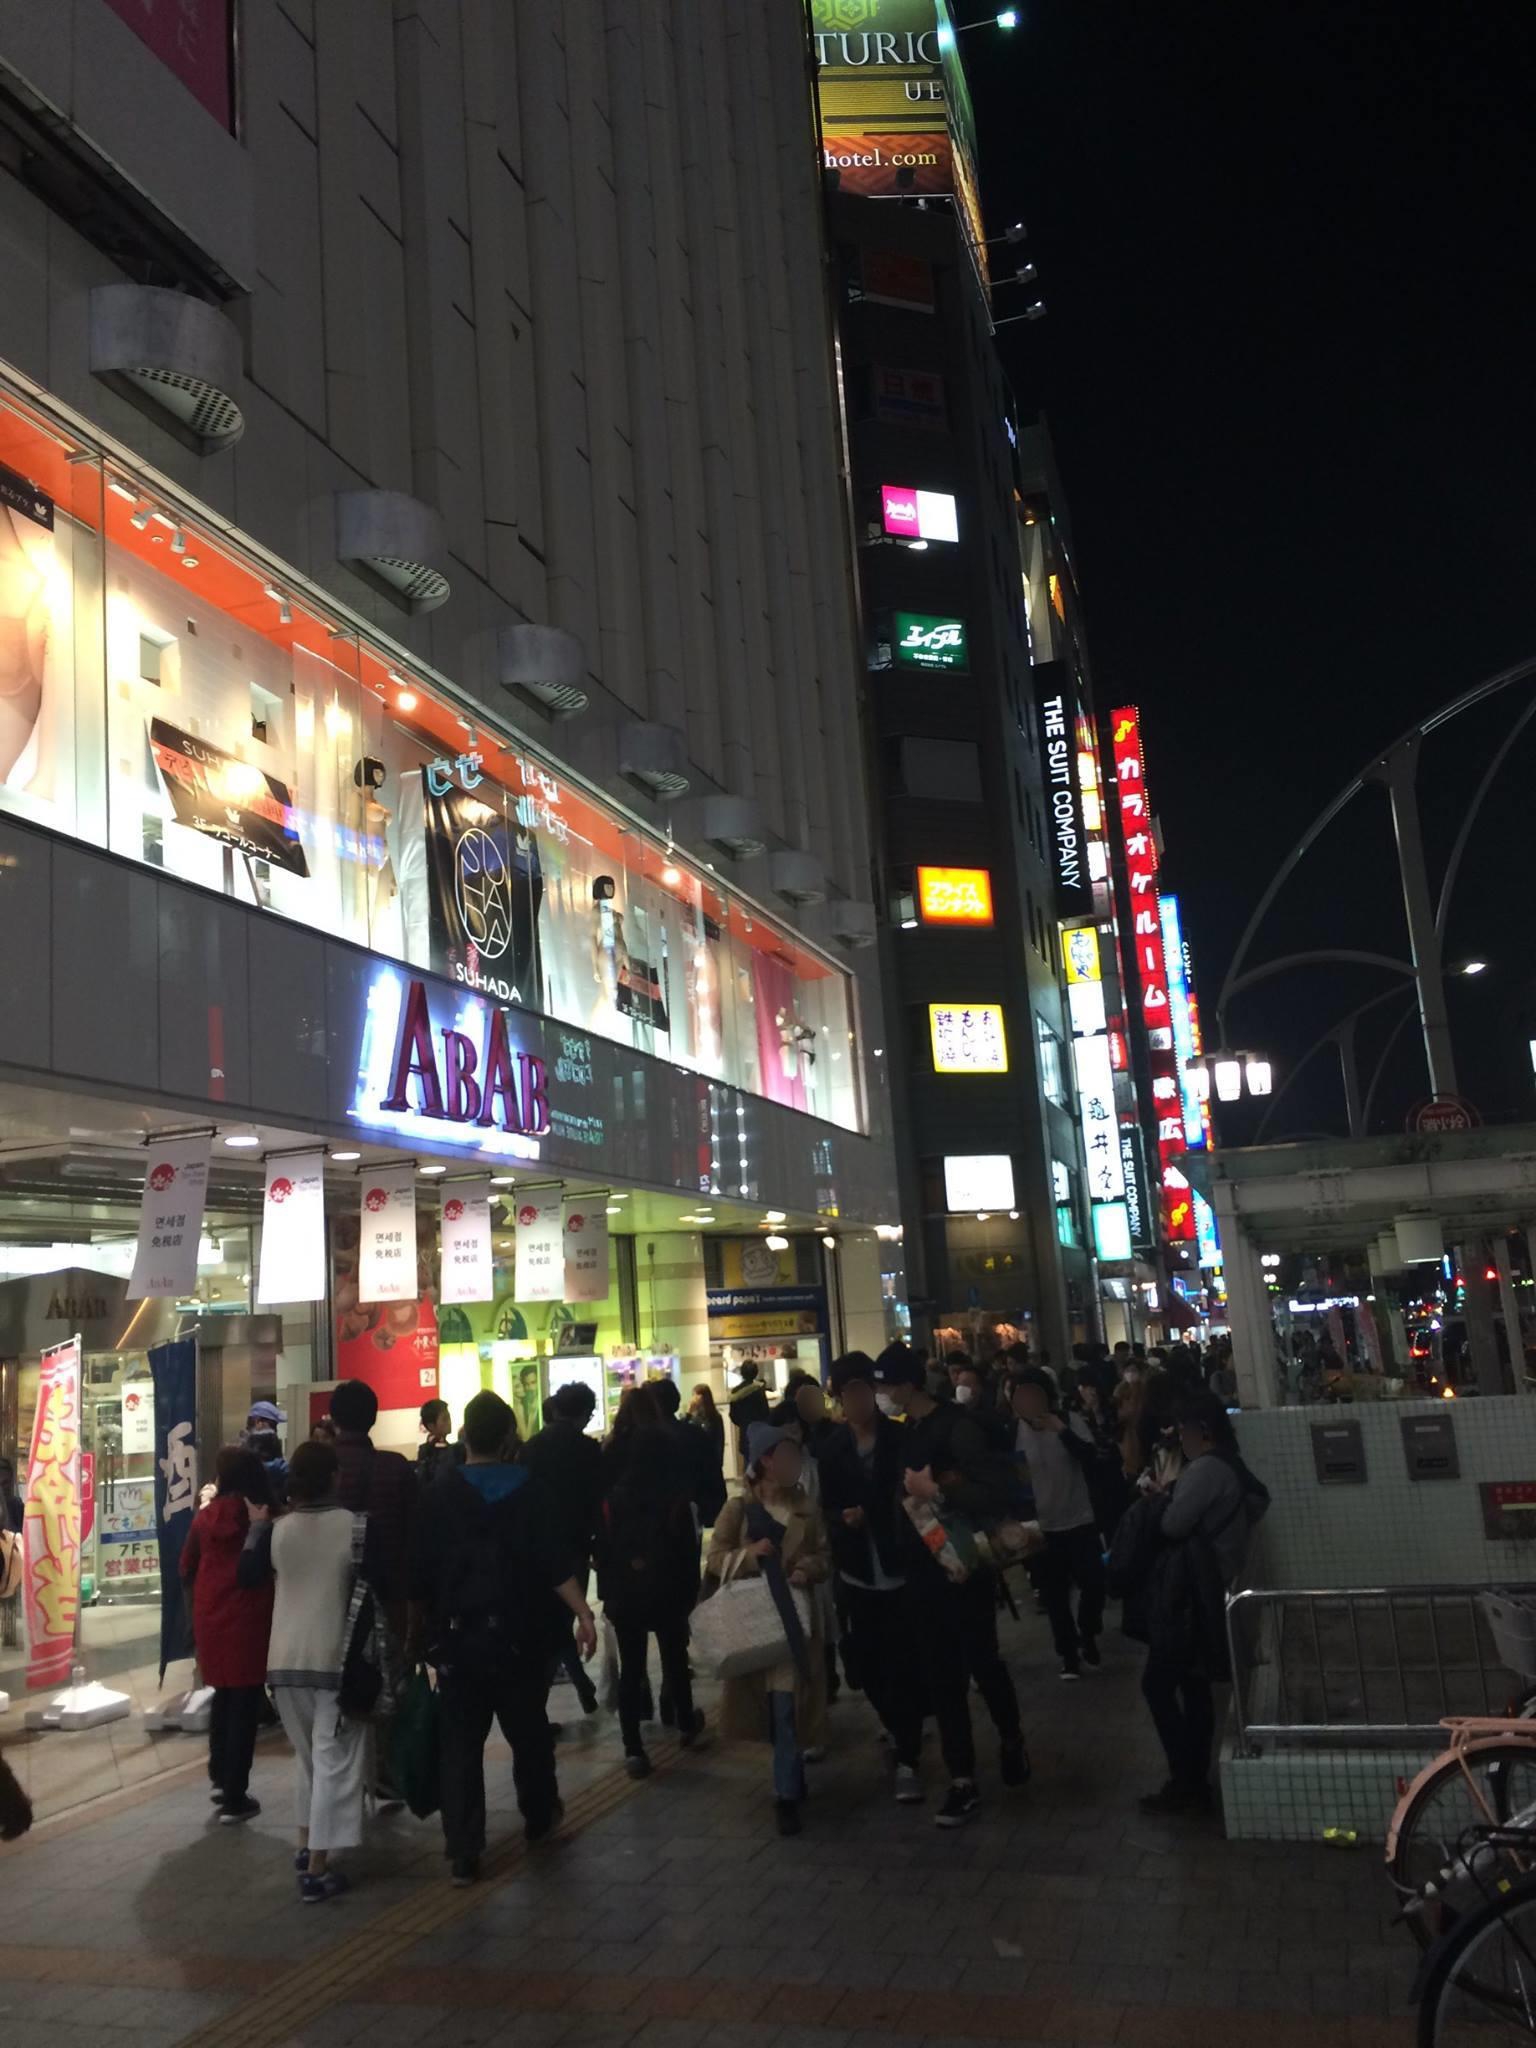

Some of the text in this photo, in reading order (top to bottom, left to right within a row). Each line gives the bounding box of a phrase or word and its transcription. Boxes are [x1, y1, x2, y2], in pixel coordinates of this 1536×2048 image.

[904, 81, 942, 101] UE
[825, 149, 937, 168] hotel.com
[1043, 695, 1081, 890] THE SUIT COMPANY
[1117, 756, 1166, 1009] カラオケルーム
[456, 962, 522, 1004] SUHADA
[1121, 1138, 1142, 1238] THE SUIT COMPANY
[155, 1214, 186, 1229] 면세점
[375, 1231, 402, 1244] 면세점
[453, 1239, 478, 1250] 면세점
